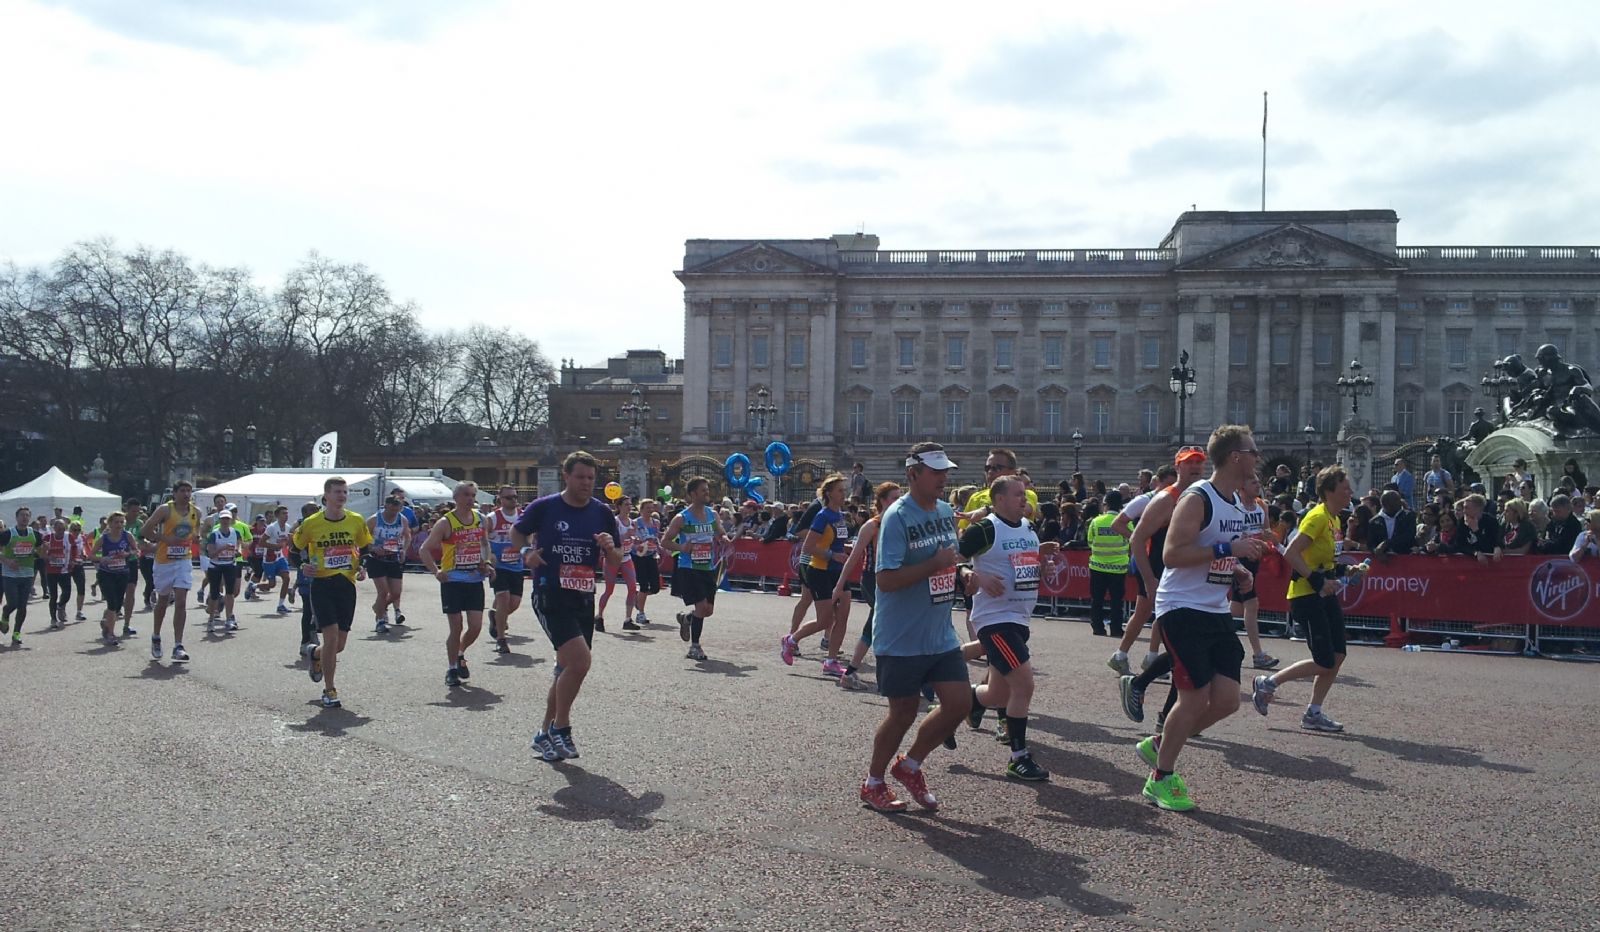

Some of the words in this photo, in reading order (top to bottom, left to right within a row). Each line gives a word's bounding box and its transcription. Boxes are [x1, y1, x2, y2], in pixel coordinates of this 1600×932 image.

[1244, 513, 1262, 524] ANT
[329, 532, 345, 540] SIR
[909, 538, 933, 549] FIGHT
[552, 545, 592, 556] ARCHIE'S
[562, 554, 583, 563] DAD
[736, 551, 758, 564] money
[562, 579, 593, 590] 40091
[1367, 576, 1429, 597] money
[1536, 567, 1584, 610] Virgin
